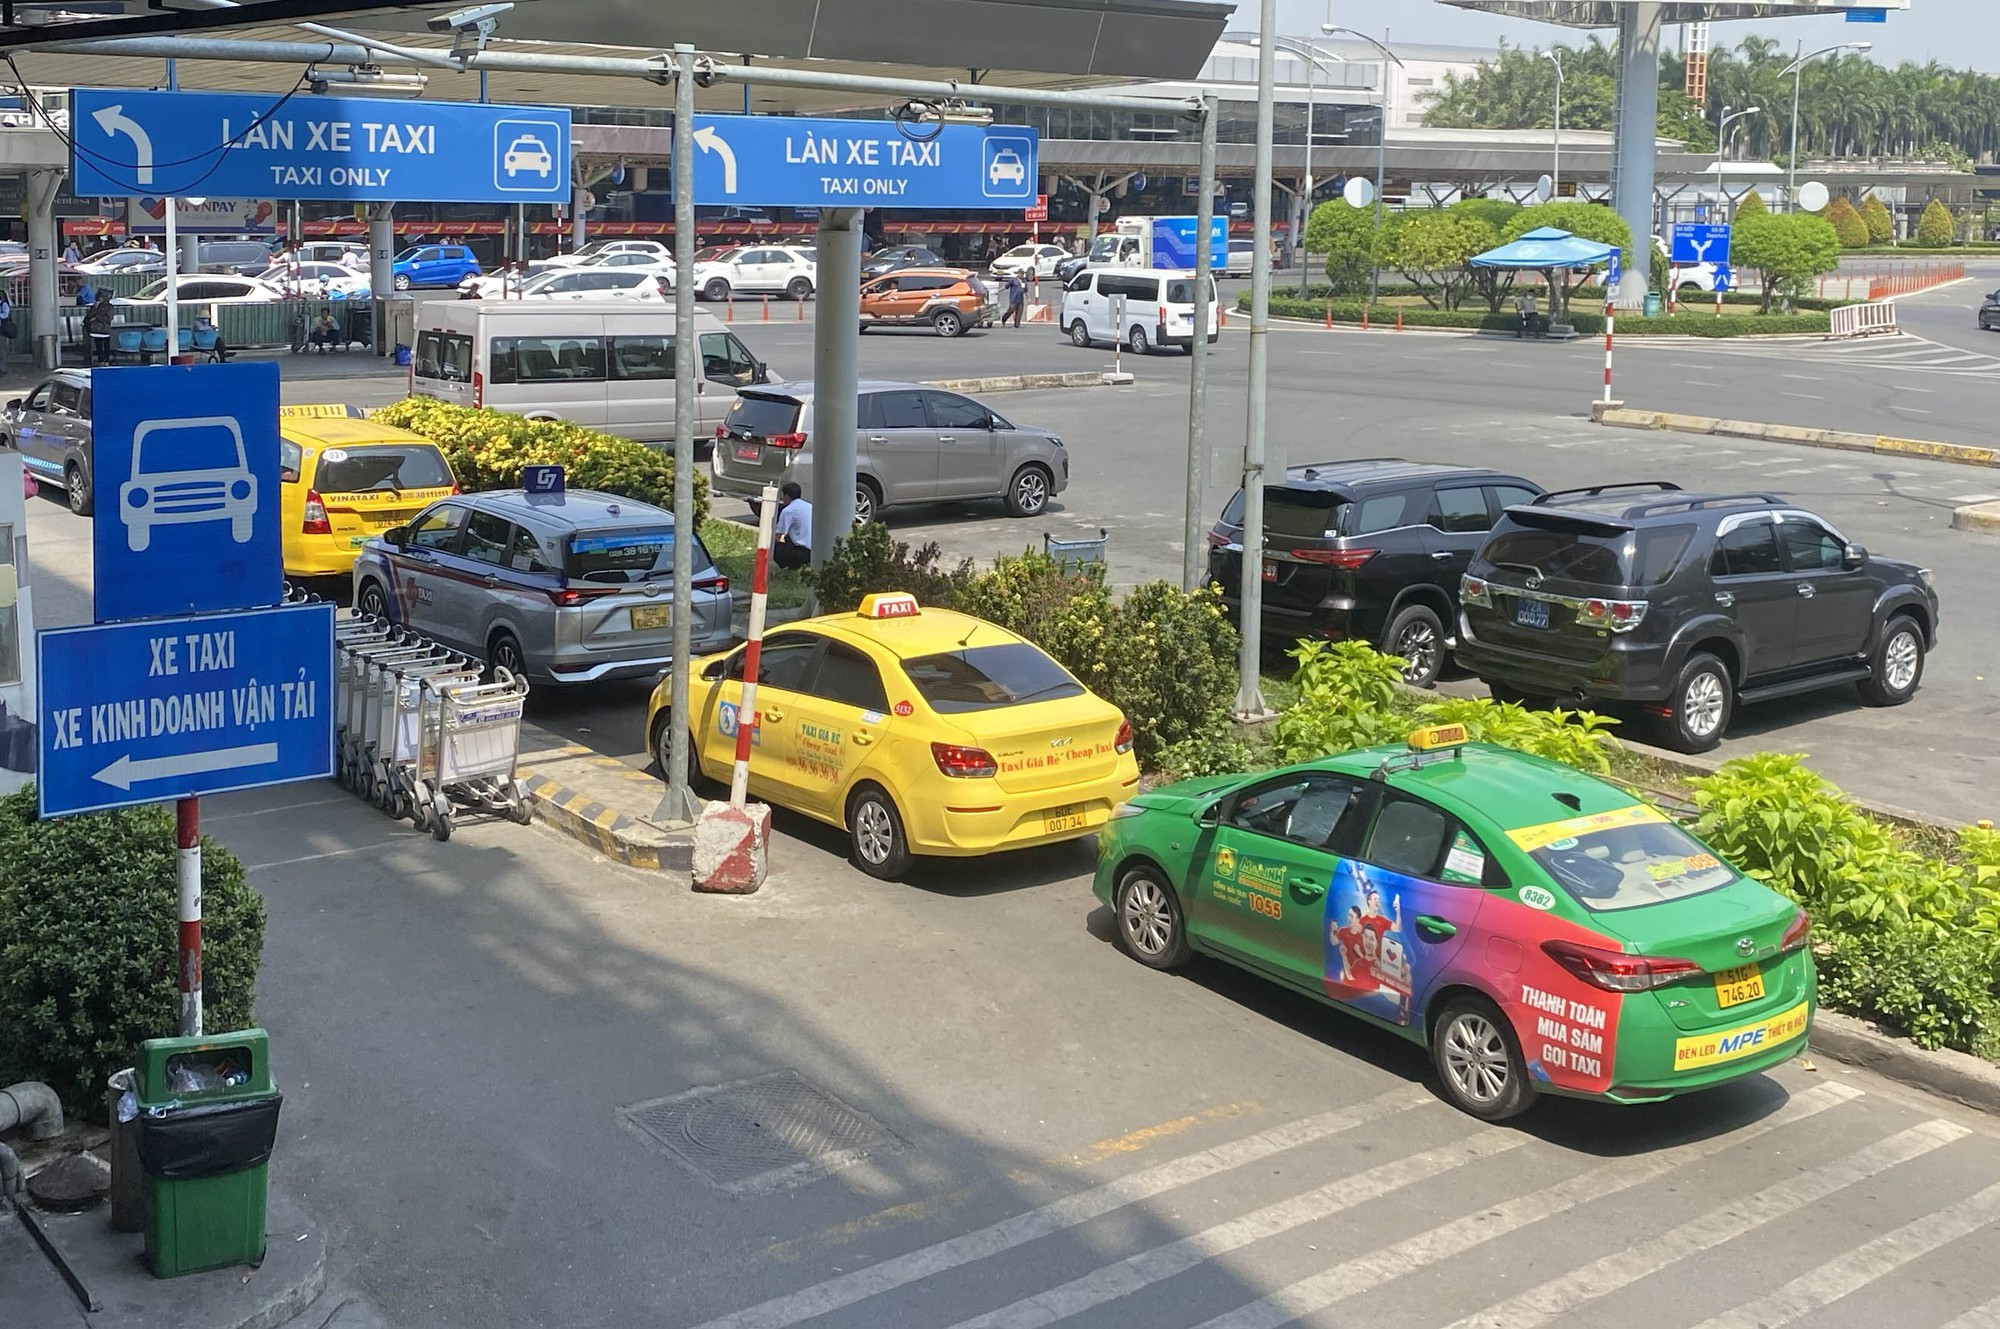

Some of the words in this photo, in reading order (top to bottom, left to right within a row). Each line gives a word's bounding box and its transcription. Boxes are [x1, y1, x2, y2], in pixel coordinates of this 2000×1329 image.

[222, 111, 293, 150] LÀN
[305, 121, 351, 151] XE
[362, 123, 435, 154] TAXI
[786, 131, 837, 165] LÀN
[846, 139, 880, 166] XE
[887, 139, 941, 167] TAXI
[270, 166, 322, 185] TAXI
[329, 167, 391, 187] ONLY
[820, 177, 859, 194] TAXI
[863, 178, 908, 195] ONLY
[1611, 256, 1618, 275] P
[537, 468, 557, 490] G7
[330, 494, 380, 503] VINATAXI
[883, 602, 912, 615] TAXI
[149, 637, 179, 677] XE
[185, 630, 236, 673] TAXI
[53, 707, 84, 751] XE
[91, 699, 146, 745] KINH
[150, 690, 226, 737] DOANH
[231, 678, 275, 731] VẬN
[280, 667, 316, 721] TẢI
[801, 723, 817, 738] TAXI
[1000, 760, 1024, 773] Taxi
[1066, 747, 1094, 761] Cheap
[1094, 741, 1113, 755] Taxi
[1049, 818, 1083, 832] 007.34
[1248, 891, 1283, 920] 1055
[1523, 888, 1551, 908] 8382
[1722, 981, 1761, 1004] 746.20
[1521, 984, 1567, 1017] THANH
[1569, 1000, 1607, 1030] TOÁN
[1537, 1016, 1568, 1044] MUA
[1699, 1043, 1716, 1057] LED
[1718, 1026, 1767, 1055] MPE
[1542, 1043, 1567, 1068] GỌI
[1569, 1052, 1601, 1078] TAXI
